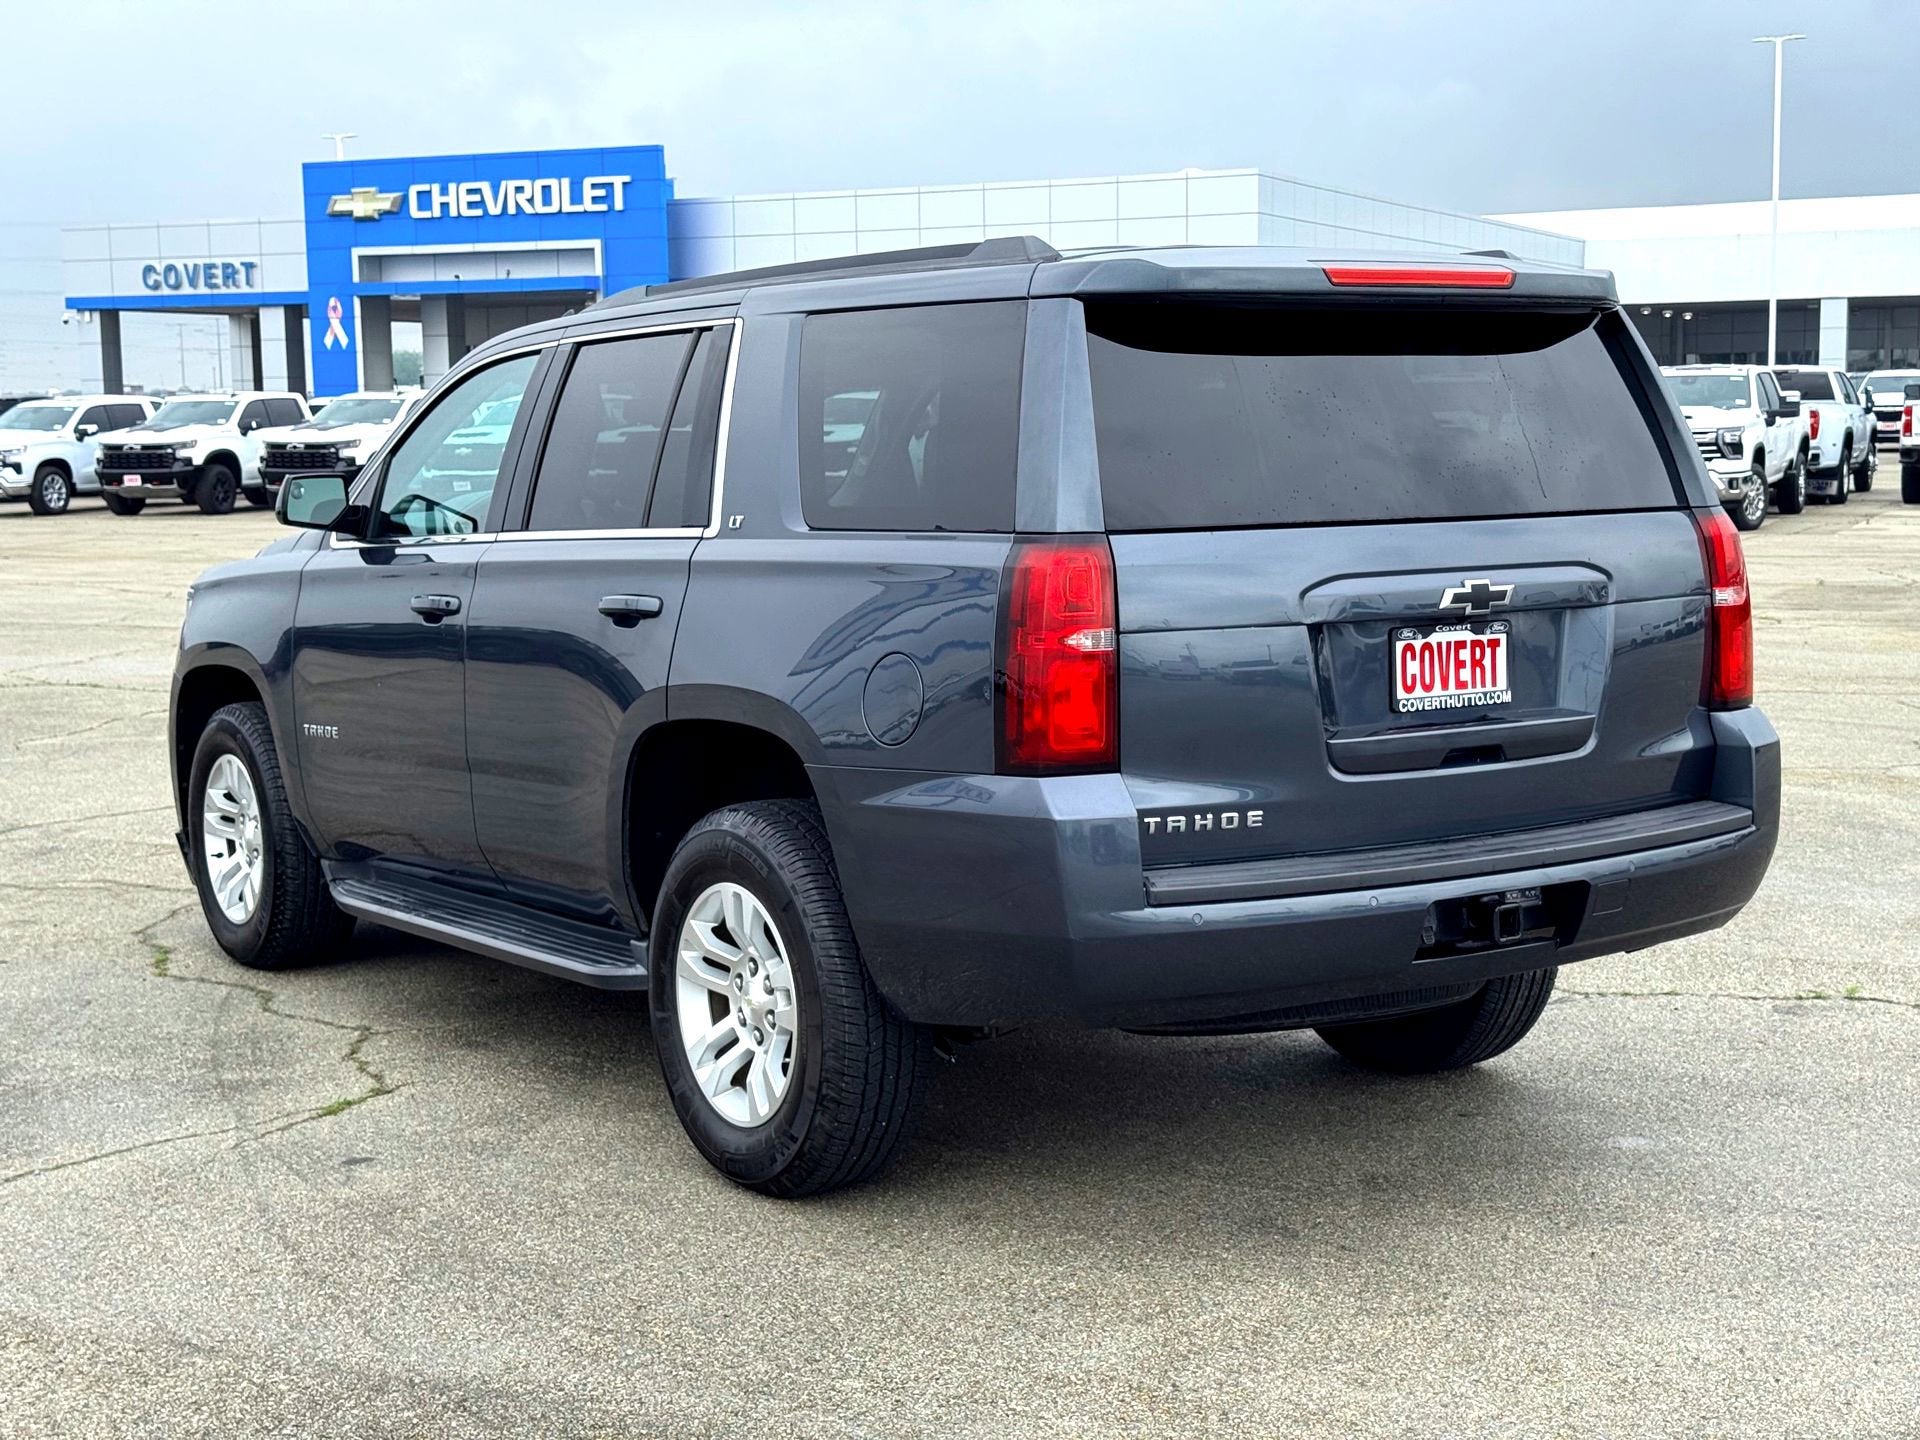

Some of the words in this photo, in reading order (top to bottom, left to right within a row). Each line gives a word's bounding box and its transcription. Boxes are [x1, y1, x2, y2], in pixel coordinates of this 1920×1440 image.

[408, 175, 632, 219] CHEVROLET
[142, 262, 257, 291] COVERT
[729, 515, 745, 529] LT
[1435, 623, 1472, 633] Covert
[1401, 638, 1501, 695] COVERT
[1398, 690, 1512, 713] COVERTHUTTO.COM
[303, 723, 340, 739] TAHOE
[1143, 810, 1264, 835] TAHOE
